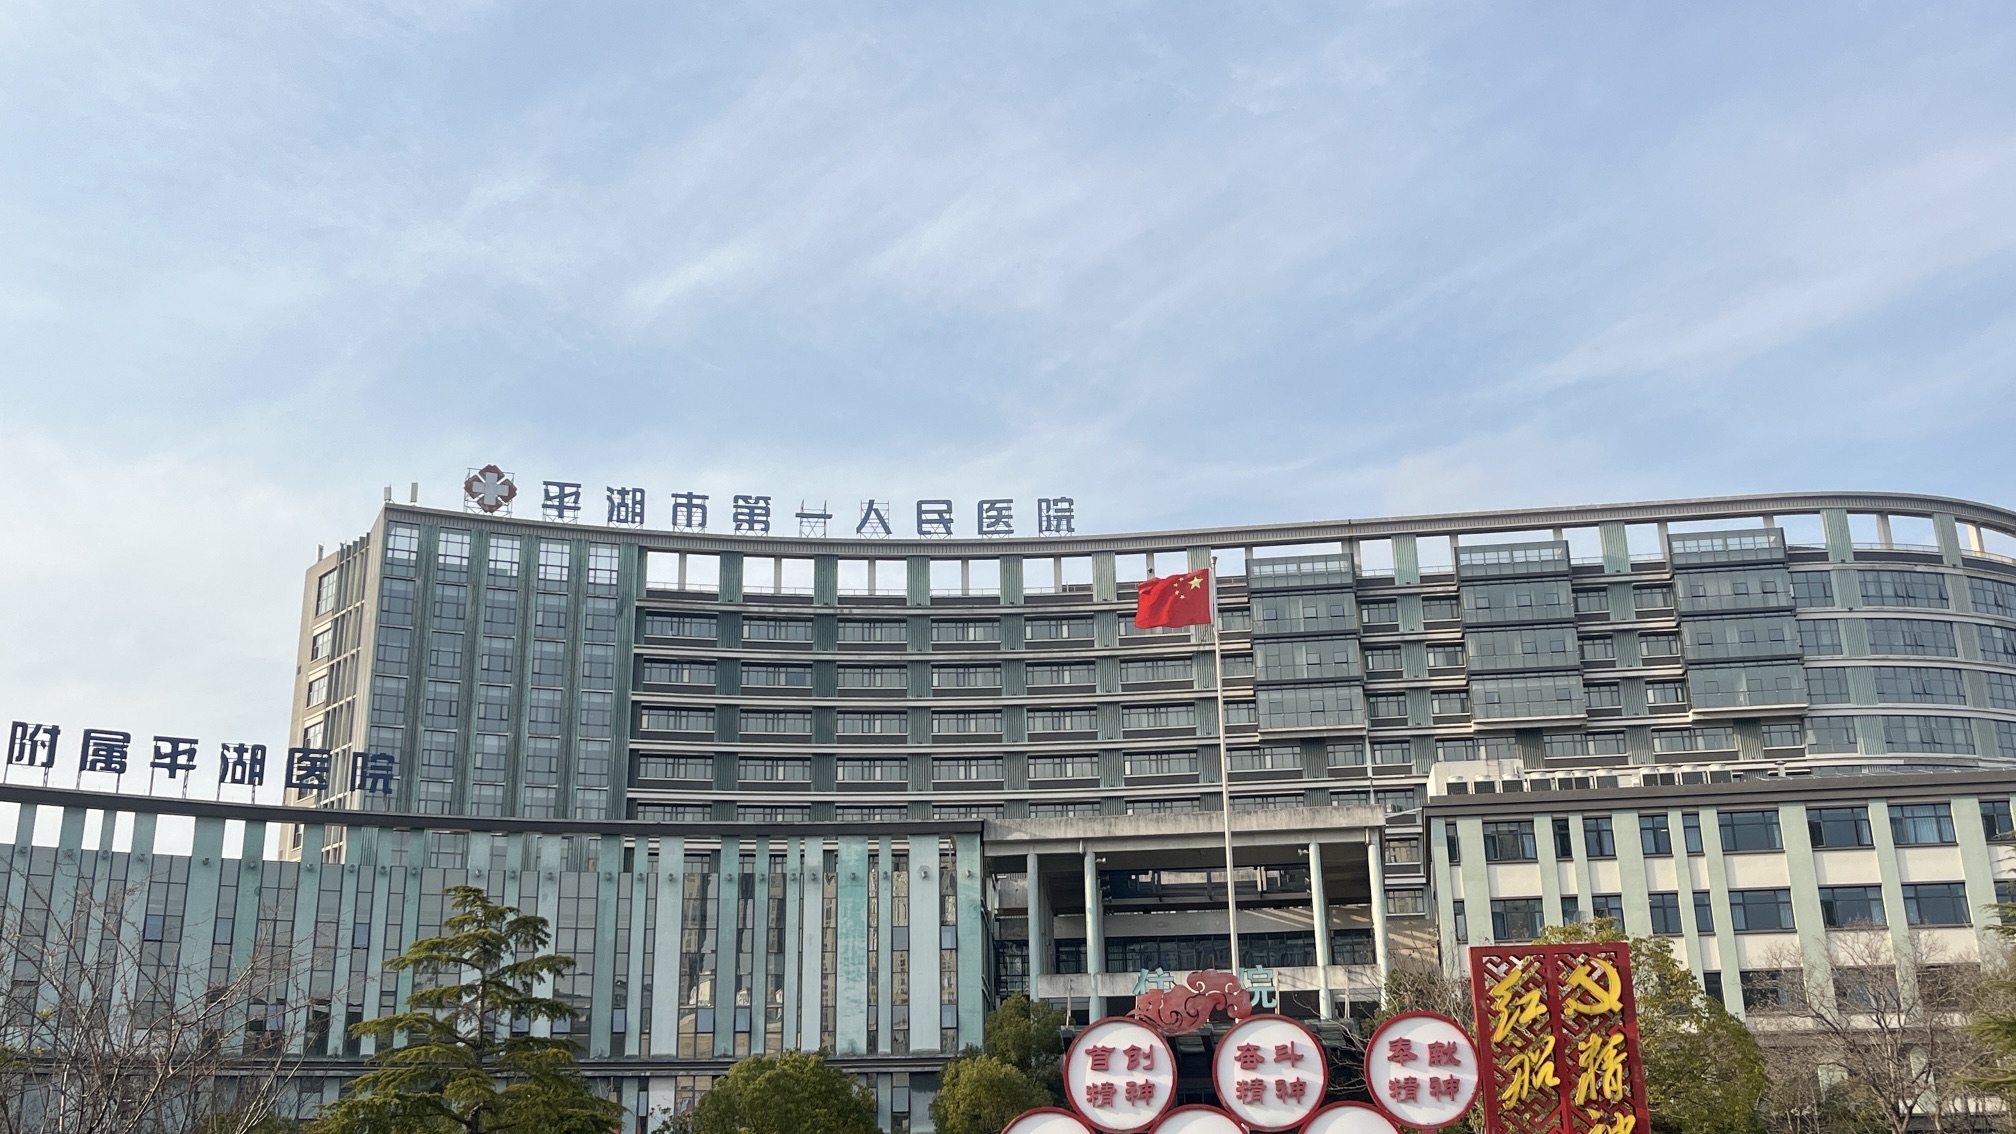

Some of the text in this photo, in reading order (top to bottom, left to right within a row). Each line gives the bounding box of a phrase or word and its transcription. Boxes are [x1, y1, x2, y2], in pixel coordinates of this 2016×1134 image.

[541, 480, 1075, 536] 平湖市第一人民医院
[7, 720, 395, 795] 附属平湖医院
[1387, 1036, 1462, 1067] 奉献
[1491, 967, 1561, 1111] 红船
[1085, 1043, 1155, 1071] 首创
[1234, 1040, 1304, 1070] 奋斗
[1086, 1078, 1156, 1108] 精神
[1235, 1076, 1307, 1105] 精神
[1388, 1073, 1461, 1104] 精神
